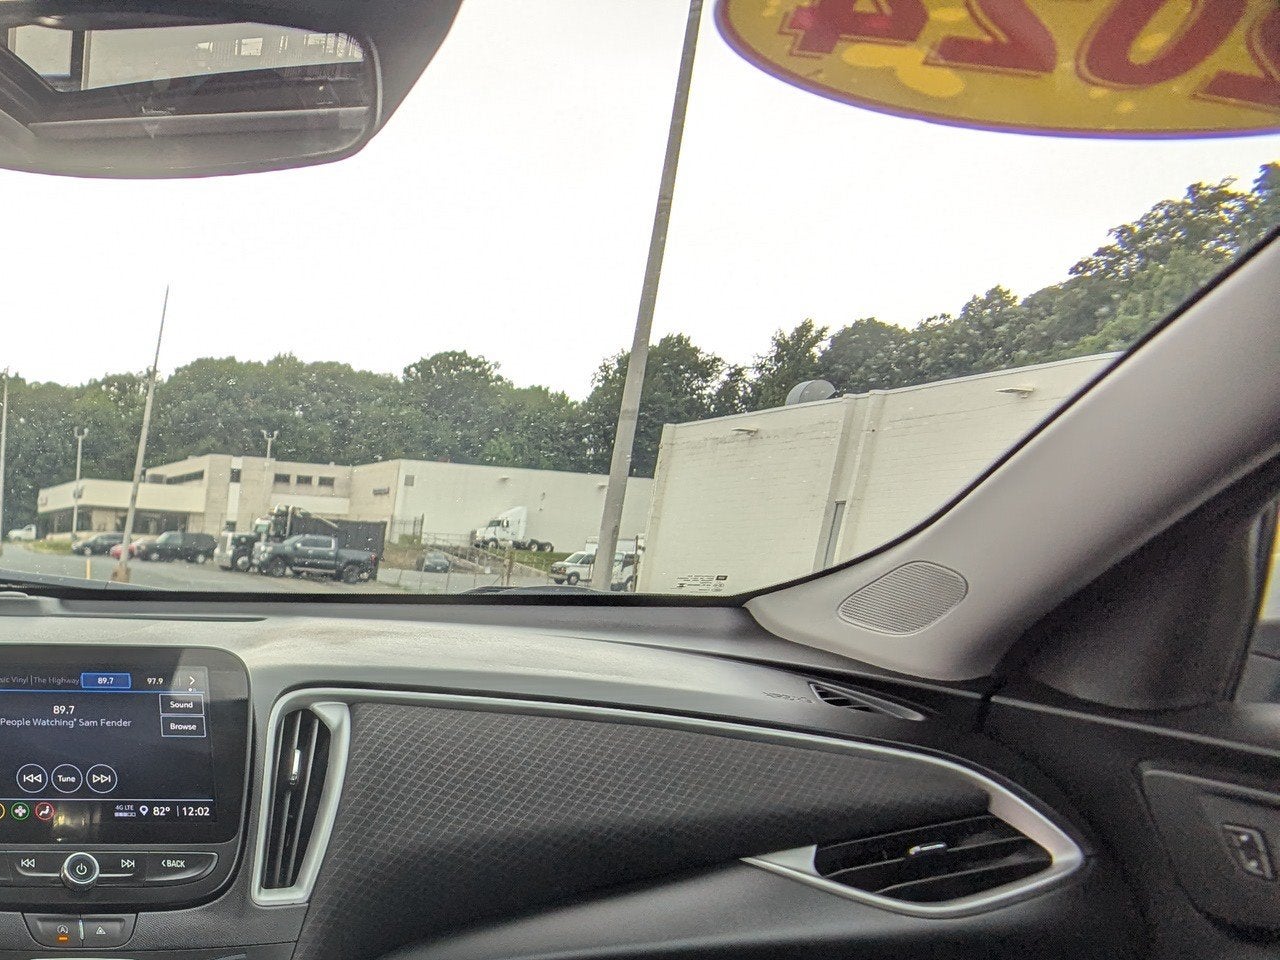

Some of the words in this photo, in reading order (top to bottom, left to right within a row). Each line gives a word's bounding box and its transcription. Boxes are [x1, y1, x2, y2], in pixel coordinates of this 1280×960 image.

[11, 675, 29, 685] Vinyl
[34, 676, 47, 684] The
[48, 676, 80, 686] Highway
[97, 677, 114, 685] 89.7
[146, 677, 164, 685] 97.9
[169, 700, 194, 709] Sound
[52, 705, 76, 715] 89.7
[78, 718, 98, 728] Sam
[99, 718, 132, 728] Fender
[169, 722, 197, 731] Browse
[57, 774, 76, 783] Tune
[152, 806, 171, 817] 82°
[181, 806, 210, 817] 12:02
[166, 859, 186, 868] BACK
